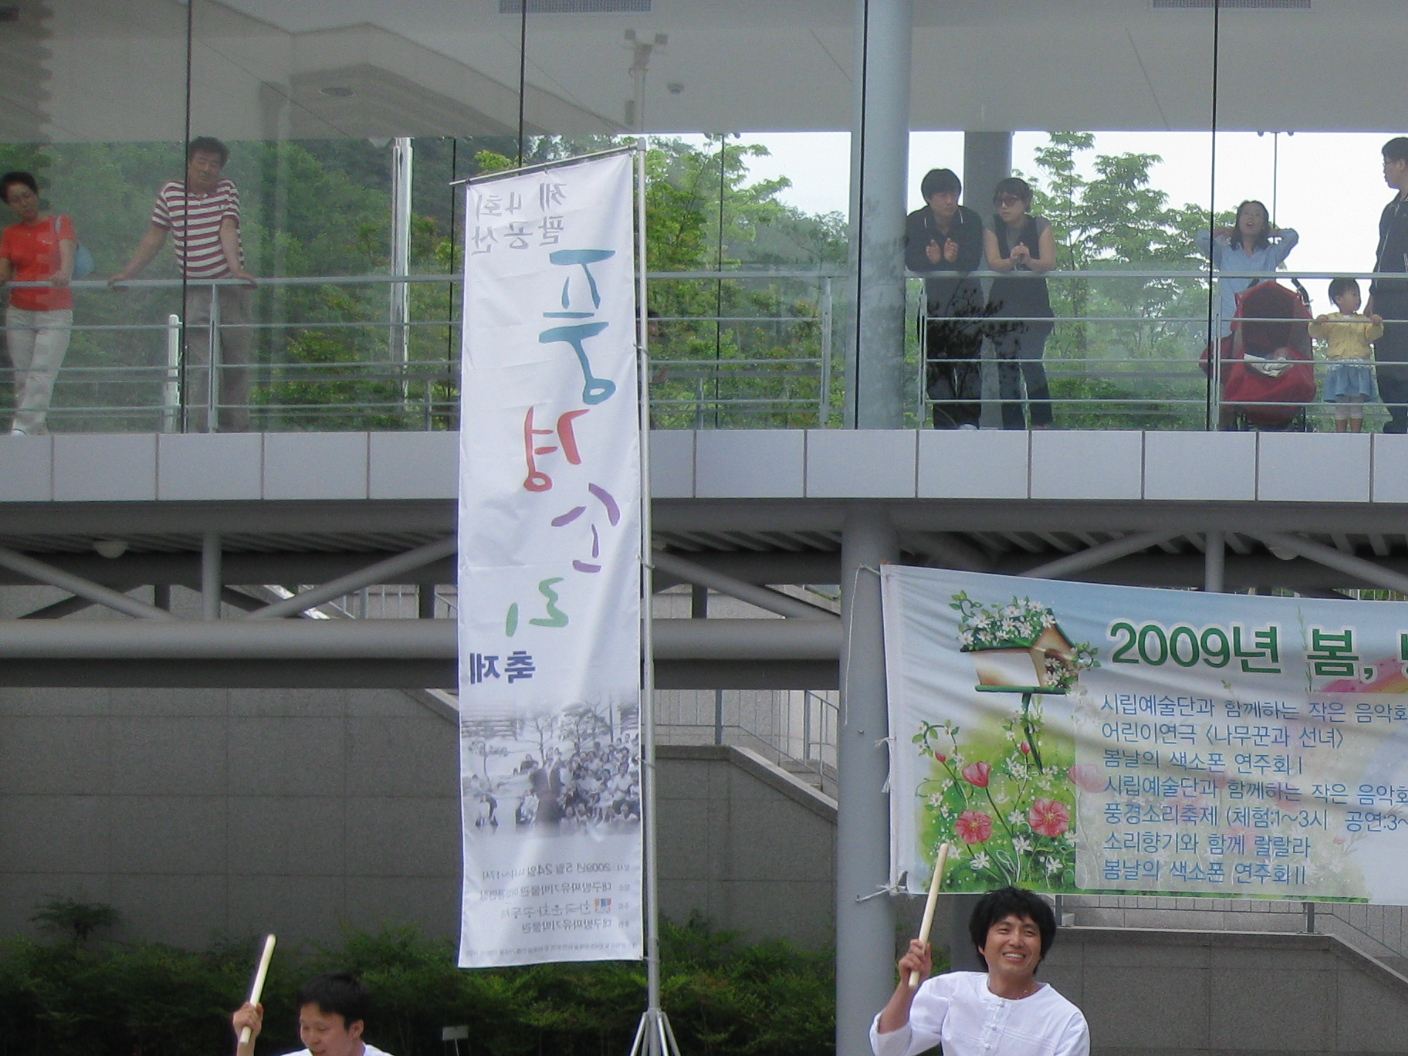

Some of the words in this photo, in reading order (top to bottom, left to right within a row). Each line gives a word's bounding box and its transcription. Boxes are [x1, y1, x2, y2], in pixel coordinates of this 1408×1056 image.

[1109, 621, 1282, 674] 2009년
[1306, 627, 1375, 680] 봄,
[1100, 693, 1215, 718] 시립예술단과
[1224, 700, 1300, 720] 함께하는
[1308, 702, 1346, 723] 작은
[1101, 721, 1197, 745] 어린이연극
[1102, 748, 1160, 770] 봄날의
[1168, 751, 1226, 773] 색소폰
[1103, 775, 1219, 799] 시립예술단과
[1227, 780, 1303, 802] 함께하는
[1311, 783, 1349, 805] 작은
[1103, 802, 1219, 828] 풍경소리축제
[1102, 831, 1200, 854] 소리향기와
[1207, 833, 1245, 856] 함께
[1253, 835, 1311, 858] 랄랄라
[1102, 859, 1160, 882] 봄날의
[1168, 860, 1225, 884] 색소폰
